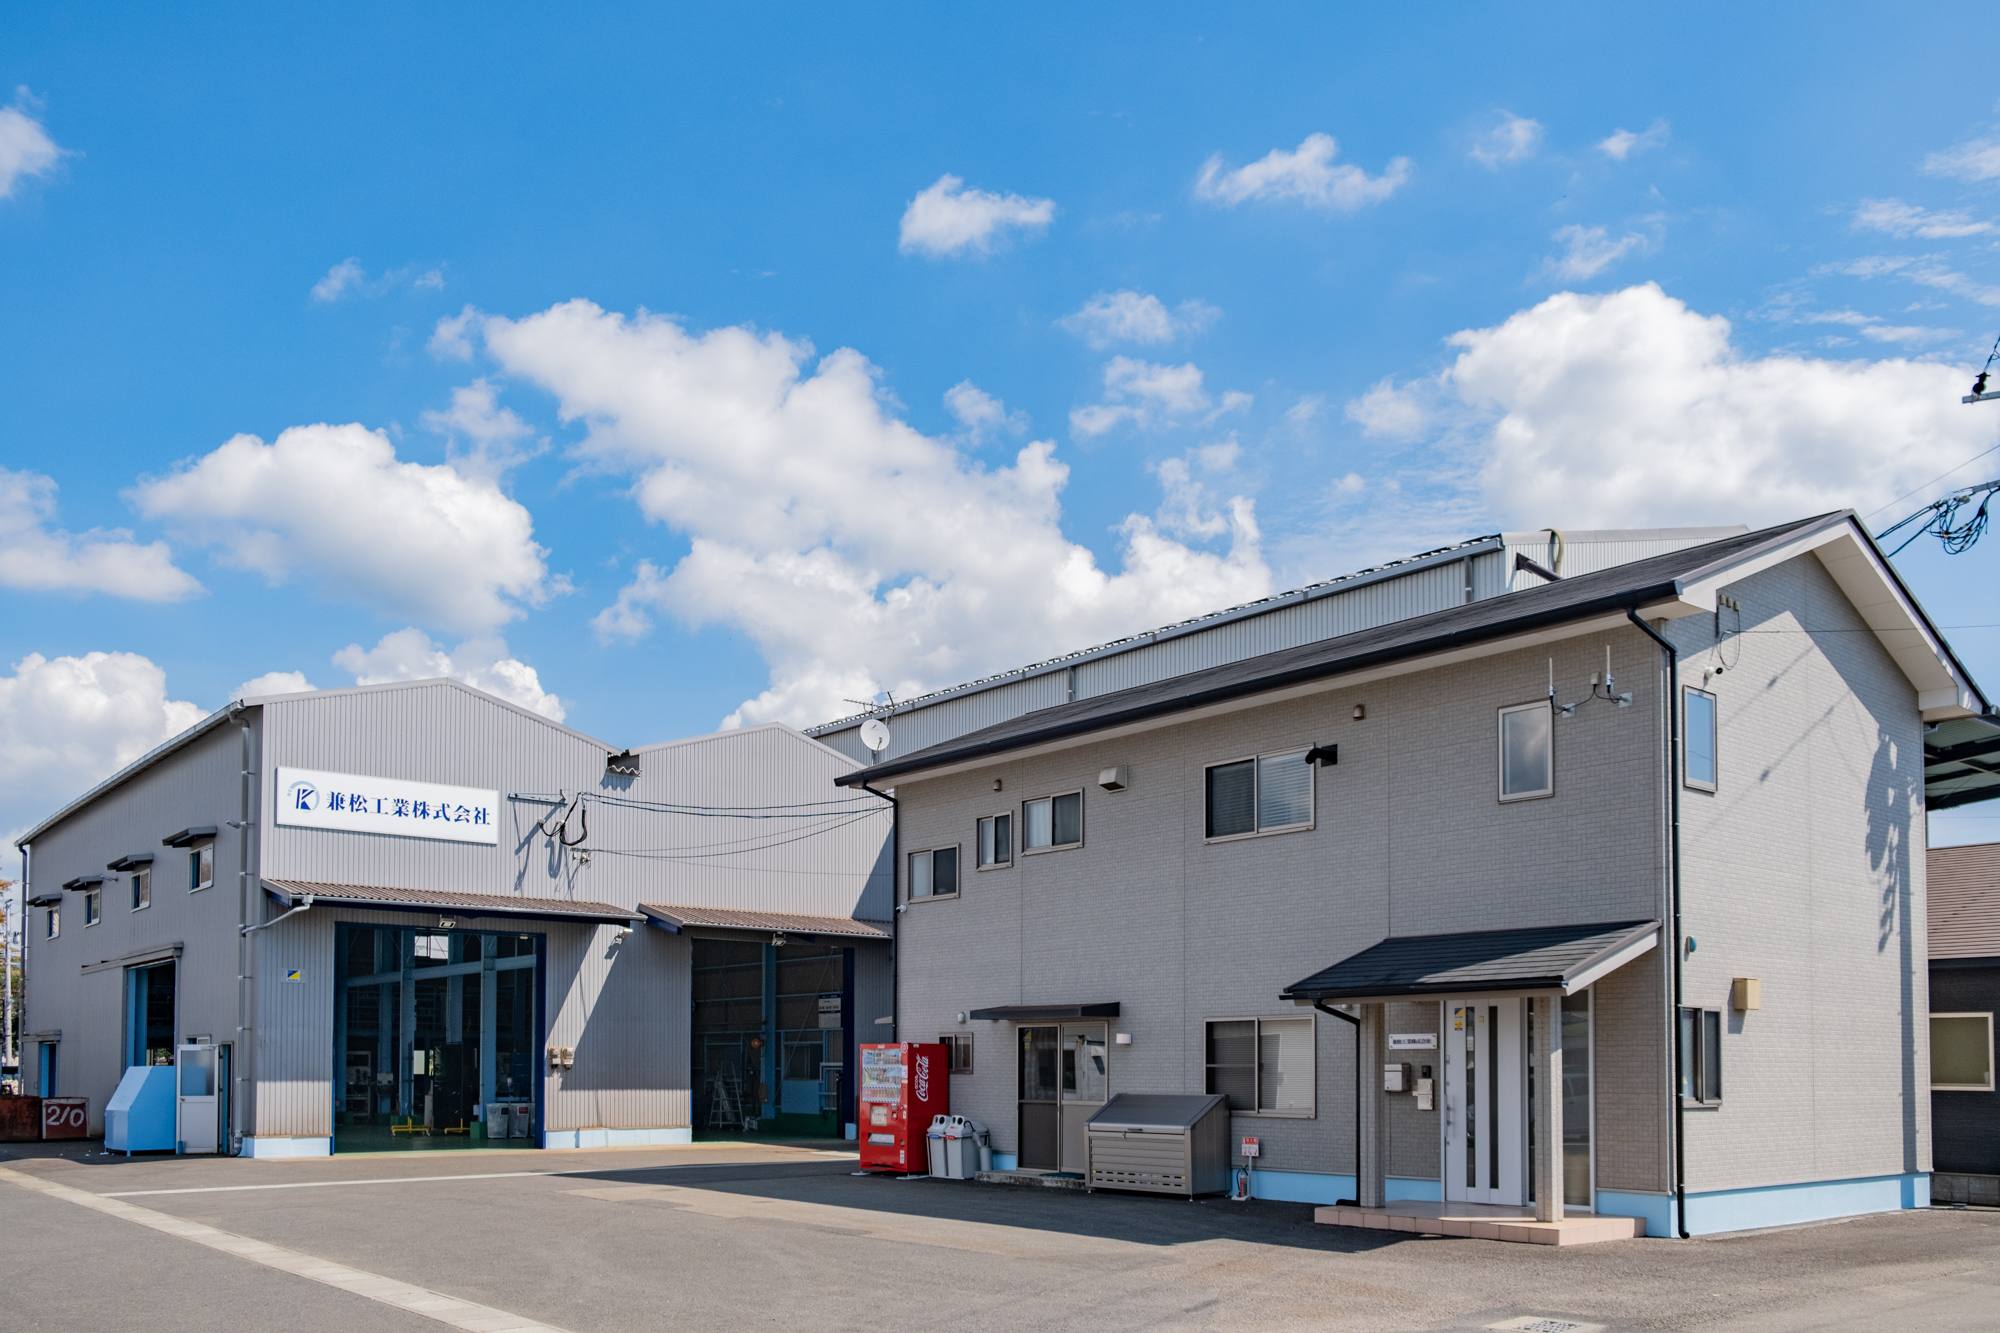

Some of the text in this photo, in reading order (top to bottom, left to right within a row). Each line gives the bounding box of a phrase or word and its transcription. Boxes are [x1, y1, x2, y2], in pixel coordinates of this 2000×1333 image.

[326, 791, 491, 825] 兼松工業株式会社
